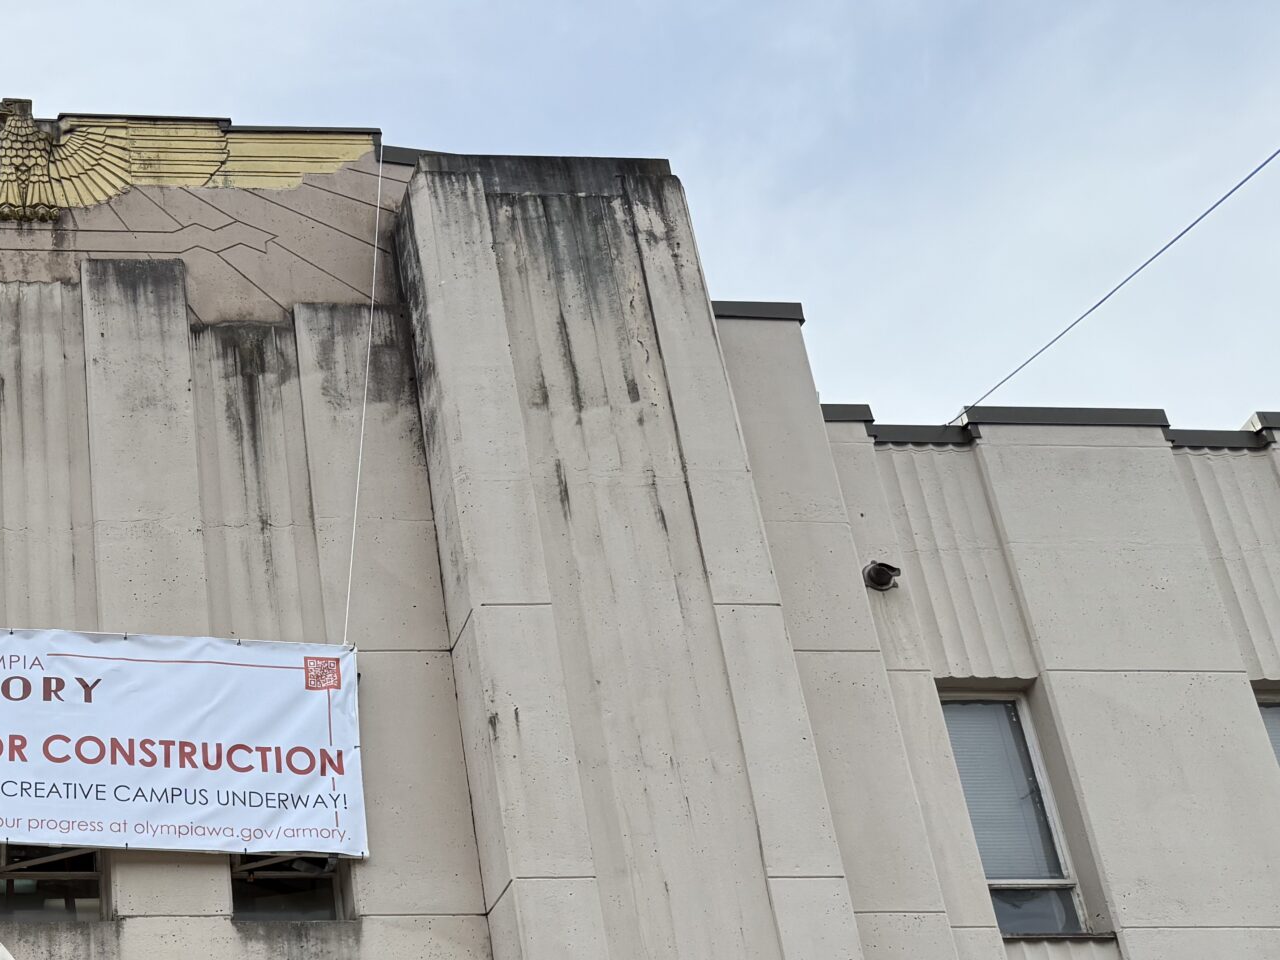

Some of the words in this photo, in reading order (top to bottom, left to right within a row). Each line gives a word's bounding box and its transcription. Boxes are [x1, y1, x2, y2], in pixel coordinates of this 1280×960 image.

[42, 733, 345, 777] CONSTRUCTION
[0, 780, 107, 801] CREATIVE
[113, 784, 209, 806] CAMPUS
[216, 789, 348, 810] UNDERWAY!
[27, 817, 105, 834] progress
[109, 819, 128, 833] at
[133, 820, 351, 843] olympiawa.gov/armory.
